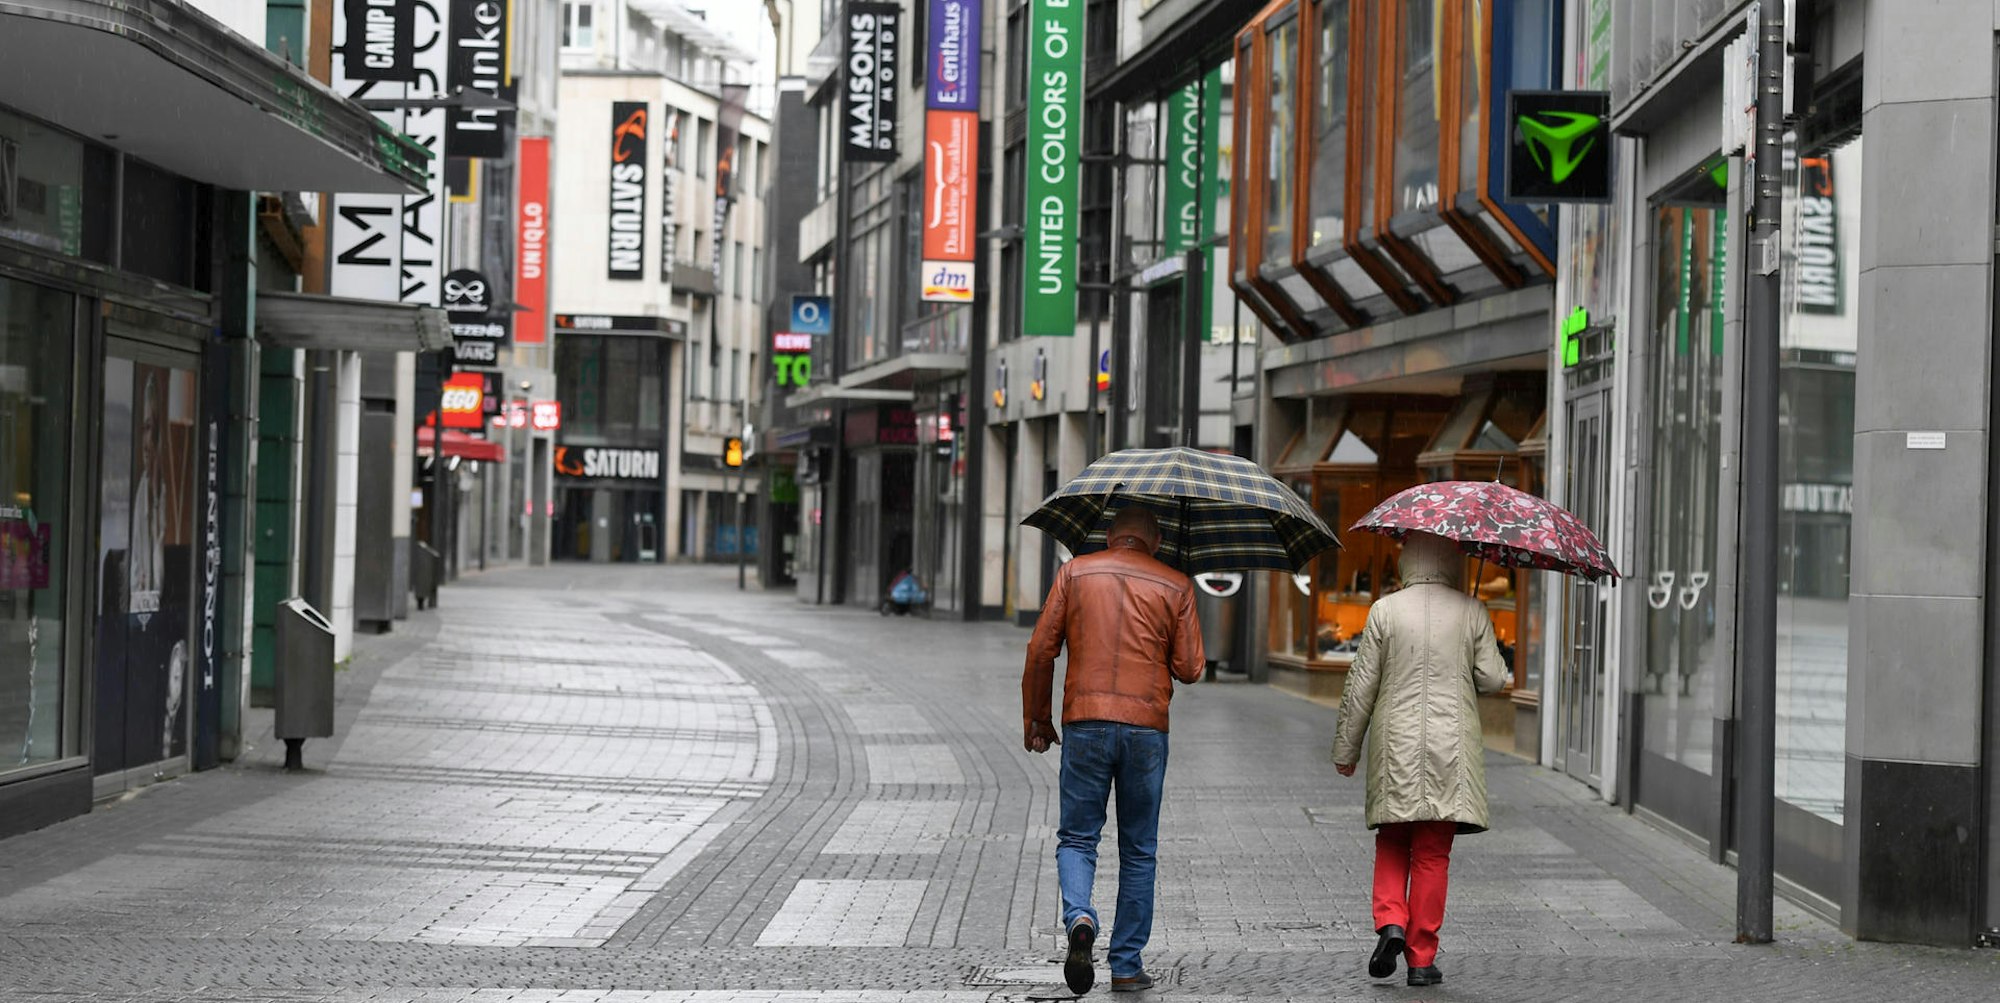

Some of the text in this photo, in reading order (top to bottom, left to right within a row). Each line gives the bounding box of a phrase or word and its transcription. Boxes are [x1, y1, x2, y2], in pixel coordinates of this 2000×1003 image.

[364, 9, 396, 69] CAMP
[1044, 20, 1069, 59] OF
[850, 13, 876, 149] MAISONS
[878, 15, 895, 150] DU MONDE
[1042, 71, 1068, 184] COLORS
[522, 202, 543, 279] UNIQLO
[610, 163, 644, 272] SATURN
[1039, 196, 1064, 294] UNITED
[932, 266, 967, 287] dm
[454, 341, 495, 361] VANS
[772, 355, 812, 387] TO
[774, 333, 812, 350] REWE
[583, 449, 660, 479] SATURN
[203, 420, 219, 691] LONGINES
